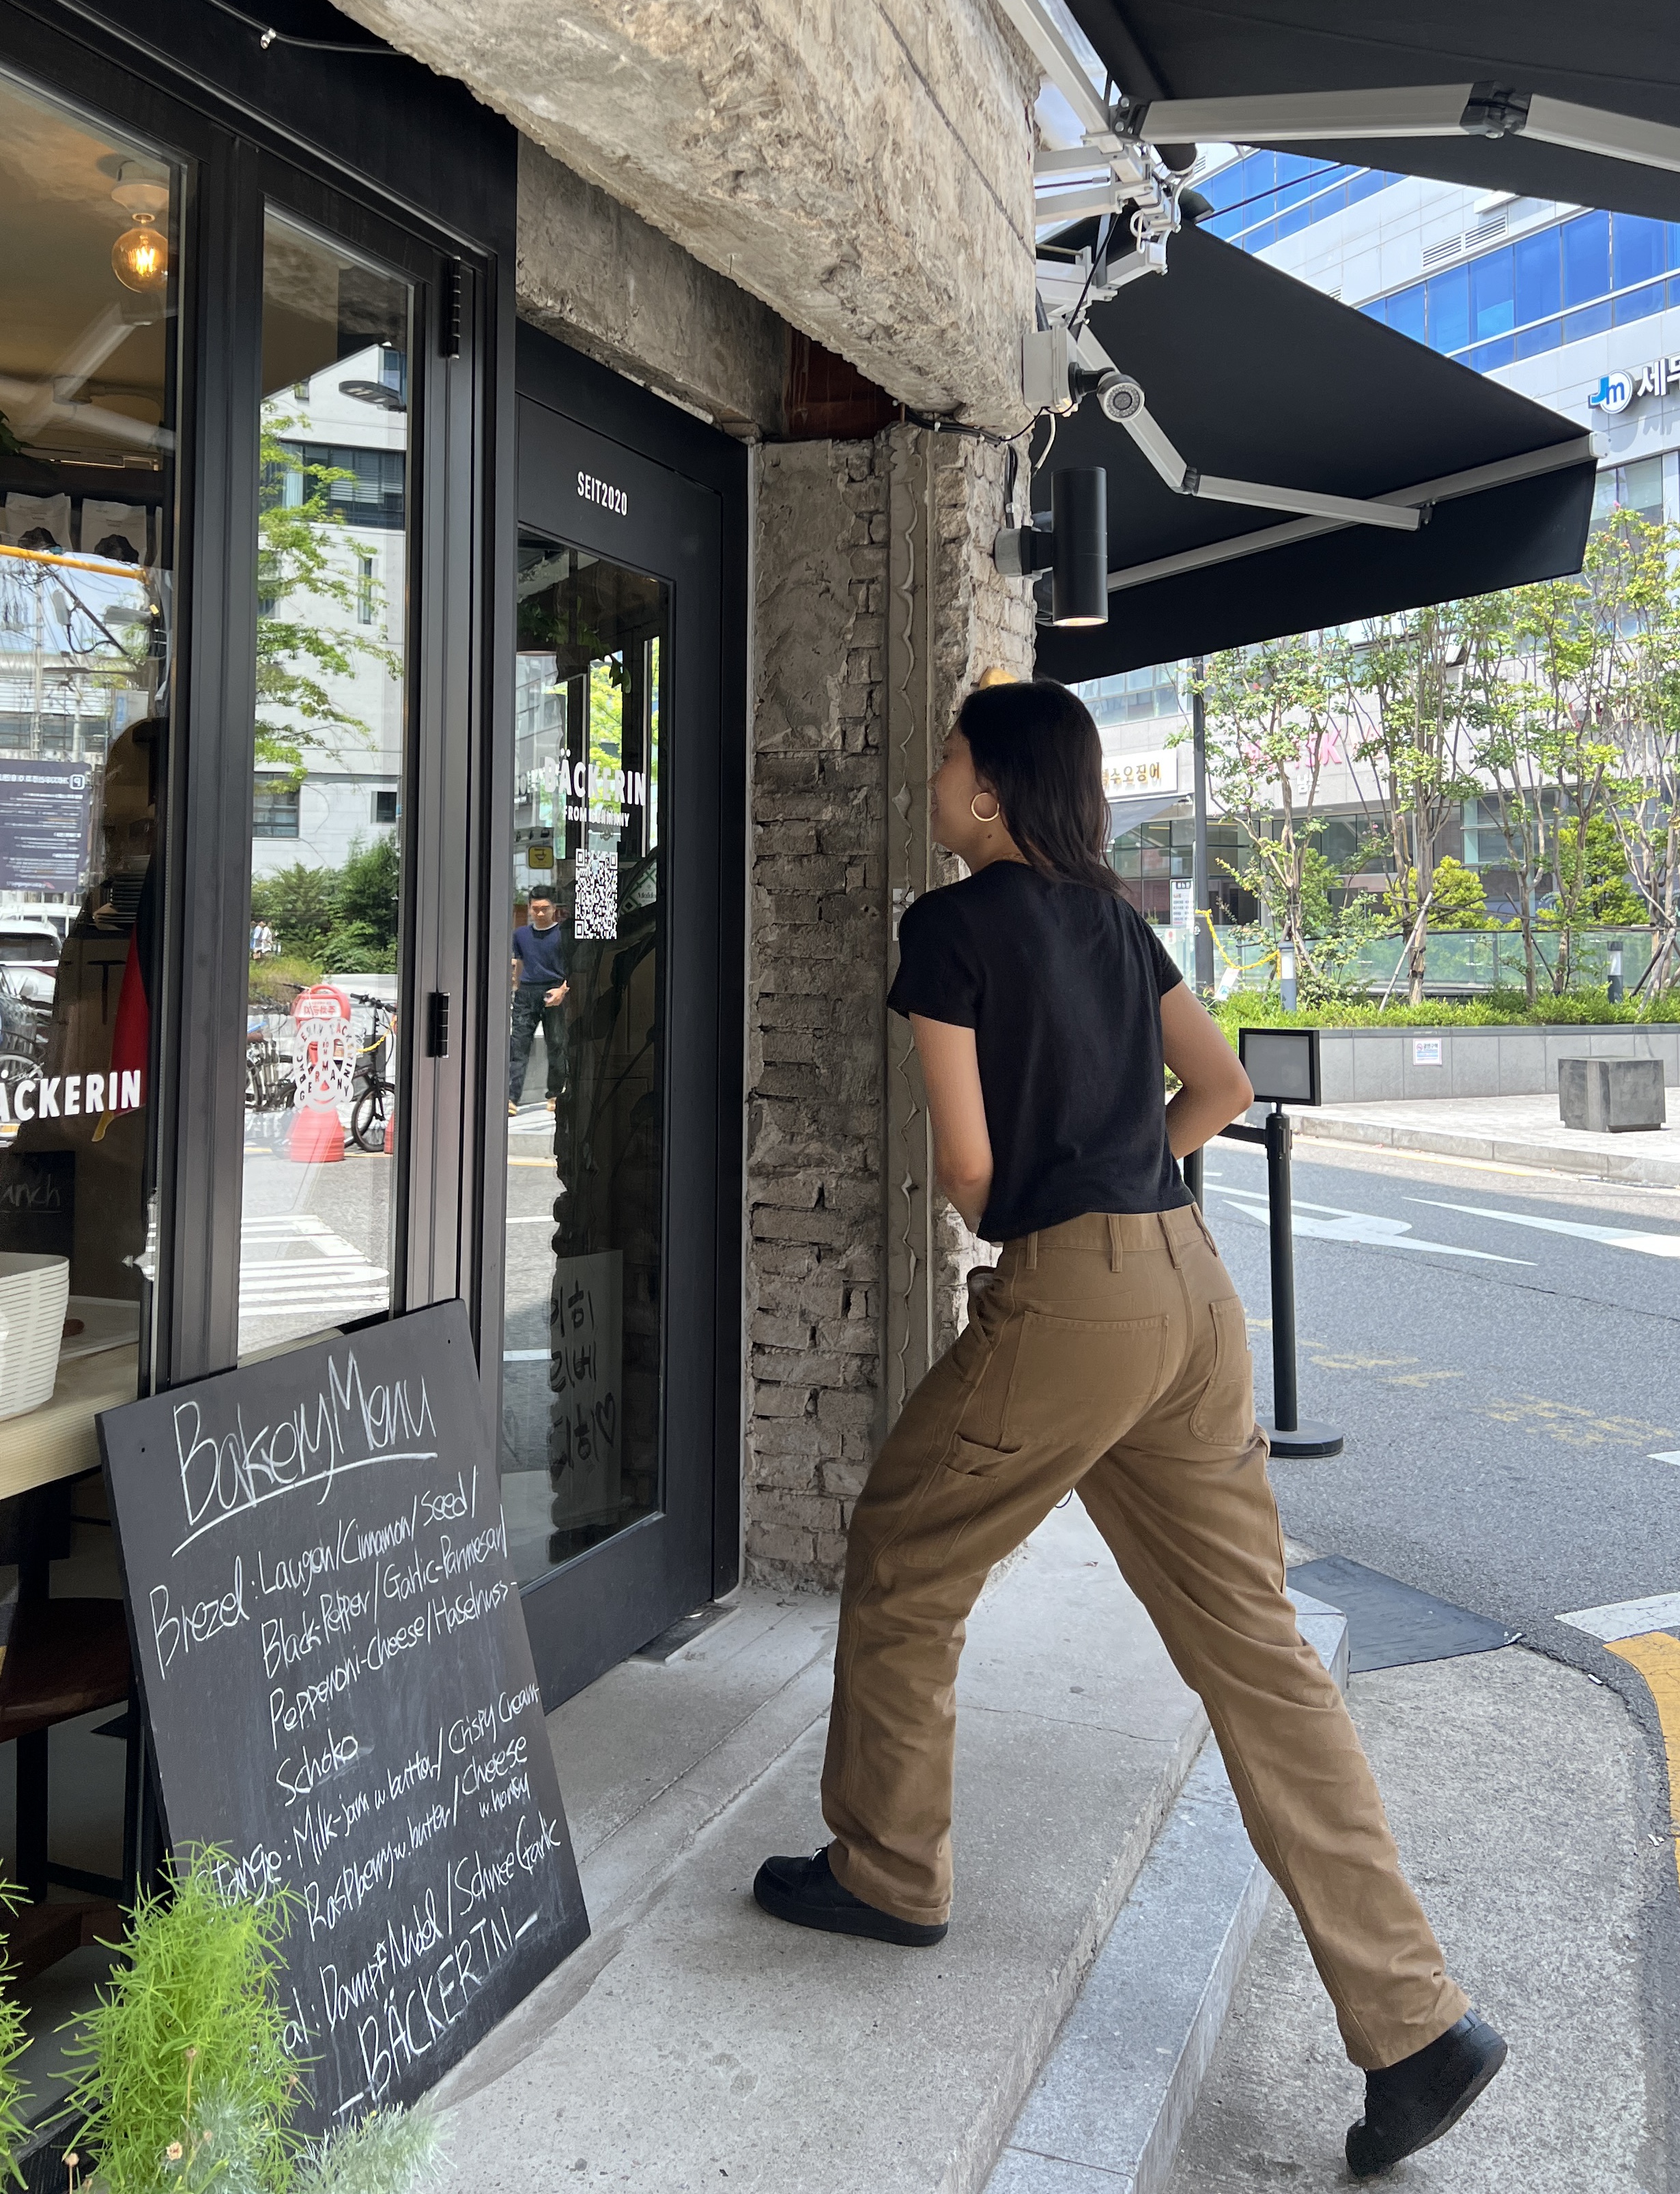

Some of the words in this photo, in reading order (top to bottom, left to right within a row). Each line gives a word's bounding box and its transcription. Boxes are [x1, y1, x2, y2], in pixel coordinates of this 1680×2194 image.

[577, 471, 627, 516] SEIT2020
[544, 747, 646, 806] BÄCKERIN
[565, 805, 587, 823] FROM
[173, 1391, 335, 1526] Bakery
[328, 1348, 437, 1455] Menu
[275, 1727, 358, 1807] Schoko
